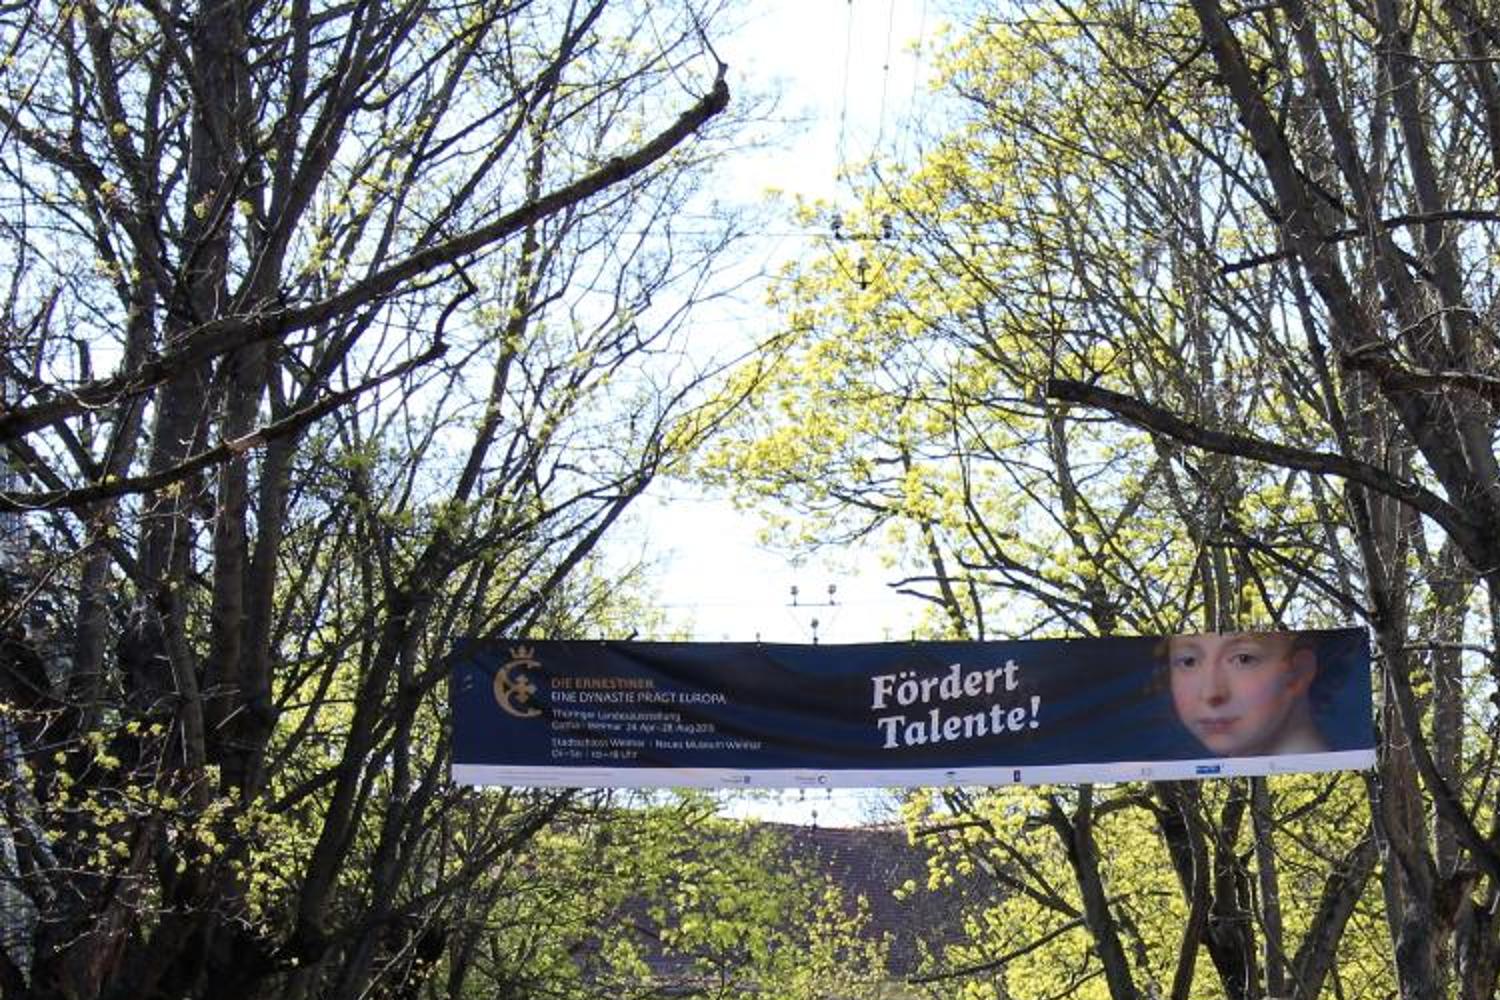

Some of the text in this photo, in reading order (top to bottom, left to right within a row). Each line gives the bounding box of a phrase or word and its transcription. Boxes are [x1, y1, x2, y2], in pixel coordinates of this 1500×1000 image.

[551, 690, 577, 703] EINE
[579, 691, 635, 703] DYNASTIE
[679, 691, 727, 705] EUROPA
[871, 659, 1019, 710] Fördert
[877, 695, 1041, 749] Talente!
